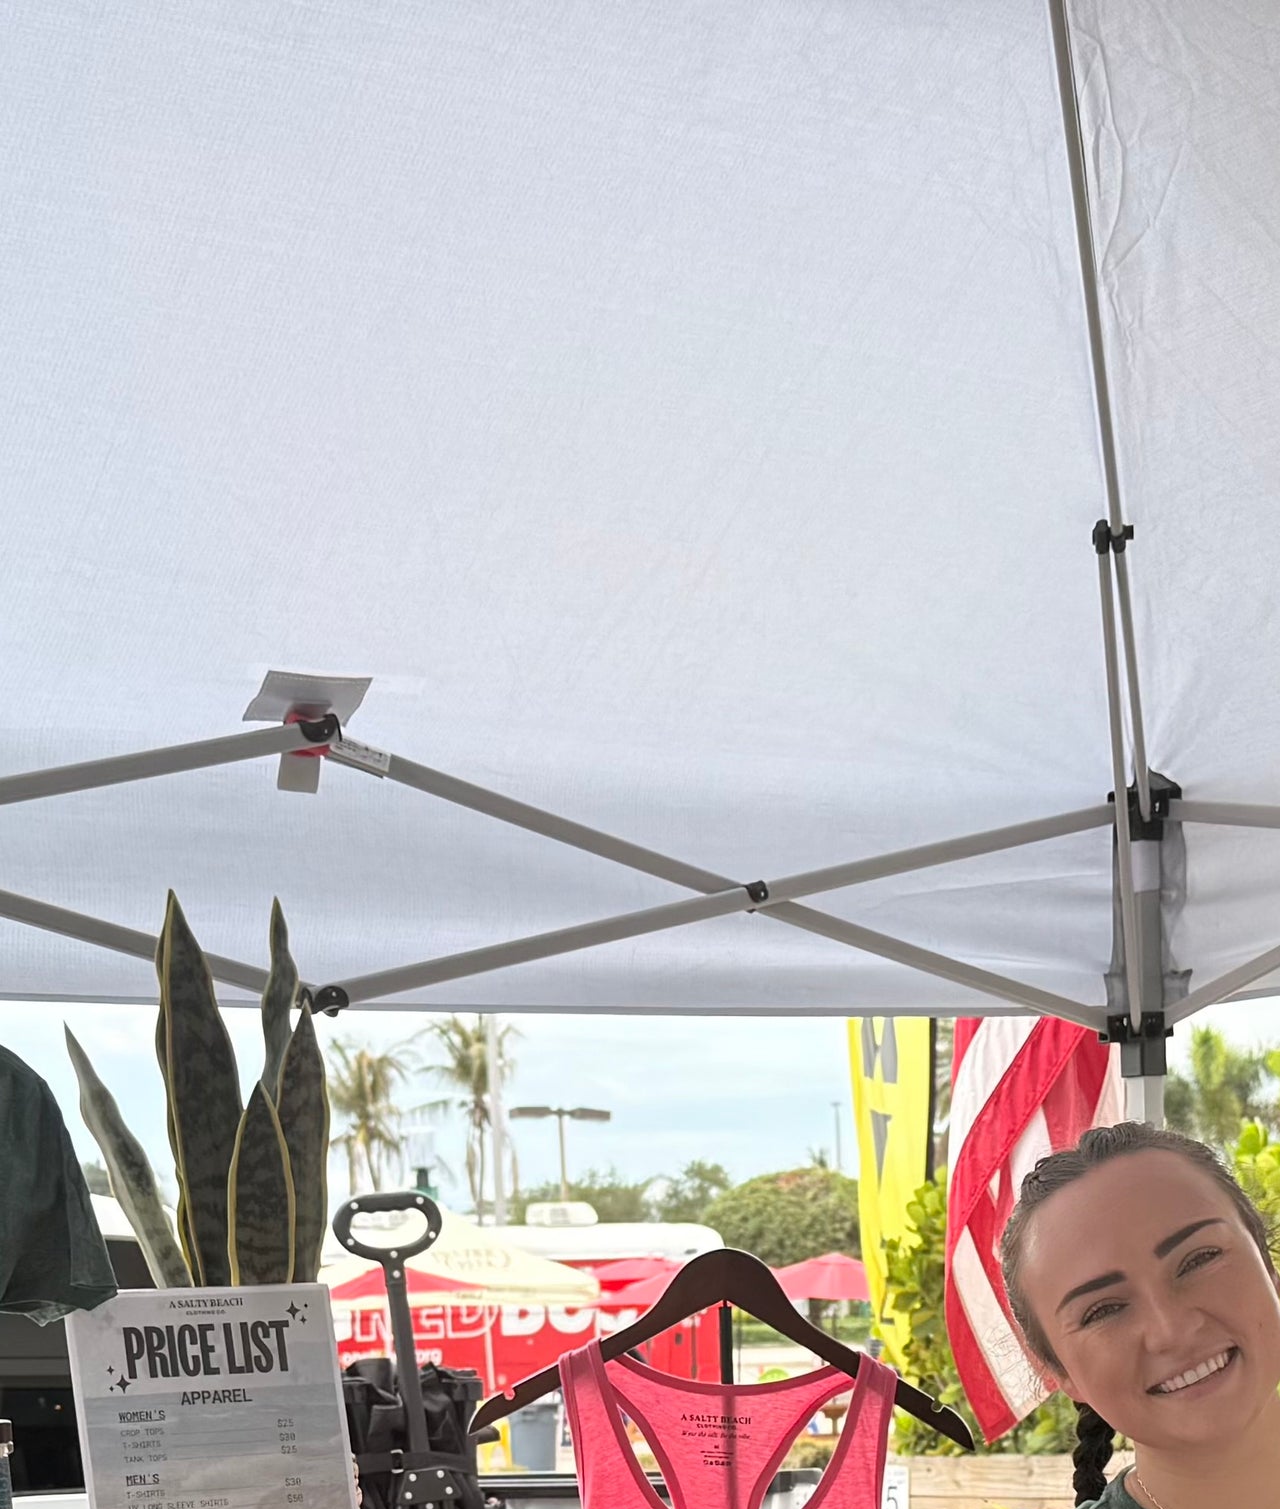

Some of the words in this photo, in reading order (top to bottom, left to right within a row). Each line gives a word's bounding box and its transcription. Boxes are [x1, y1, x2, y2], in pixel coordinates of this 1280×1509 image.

[168, 1299, 177, 1310] A
[177, 1299, 210, 1310] SALTY
[210, 1297, 244, 1308] BEACH
[122, 1323, 221, 1380] PRICE
[222, 1319, 289, 1375] LIST
[180, 1388, 254, 1406] APPAREL
[118, 1410, 166, 1423] WOMEN'S
[680, 1413, 688, 1421] A
[689, 1414, 719, 1424] SALTY
[720, 1415, 751, 1425] BEACH
[120, 1428, 140, 1438] CROP
[144, 1427, 165, 1437] TOPS
[277, 1418, 294, 1428] $25
[122, 1440, 162, 1450] T-SHIRTS
[279, 1432, 296, 1442] $30
[124, 1455, 145, 1464] TANK
[149, 1453, 168, 1463] TOPS
[280, 1445, 298, 1455] $25
[125, 1473, 160, 1486] MEN'S
[126, 1490, 166, 1500] T-SHIRTS
[284, 1477, 302, 1487] $30
[200, 1498, 230, 1509] SHIRTS
[287, 1493, 304, 1504] $50
